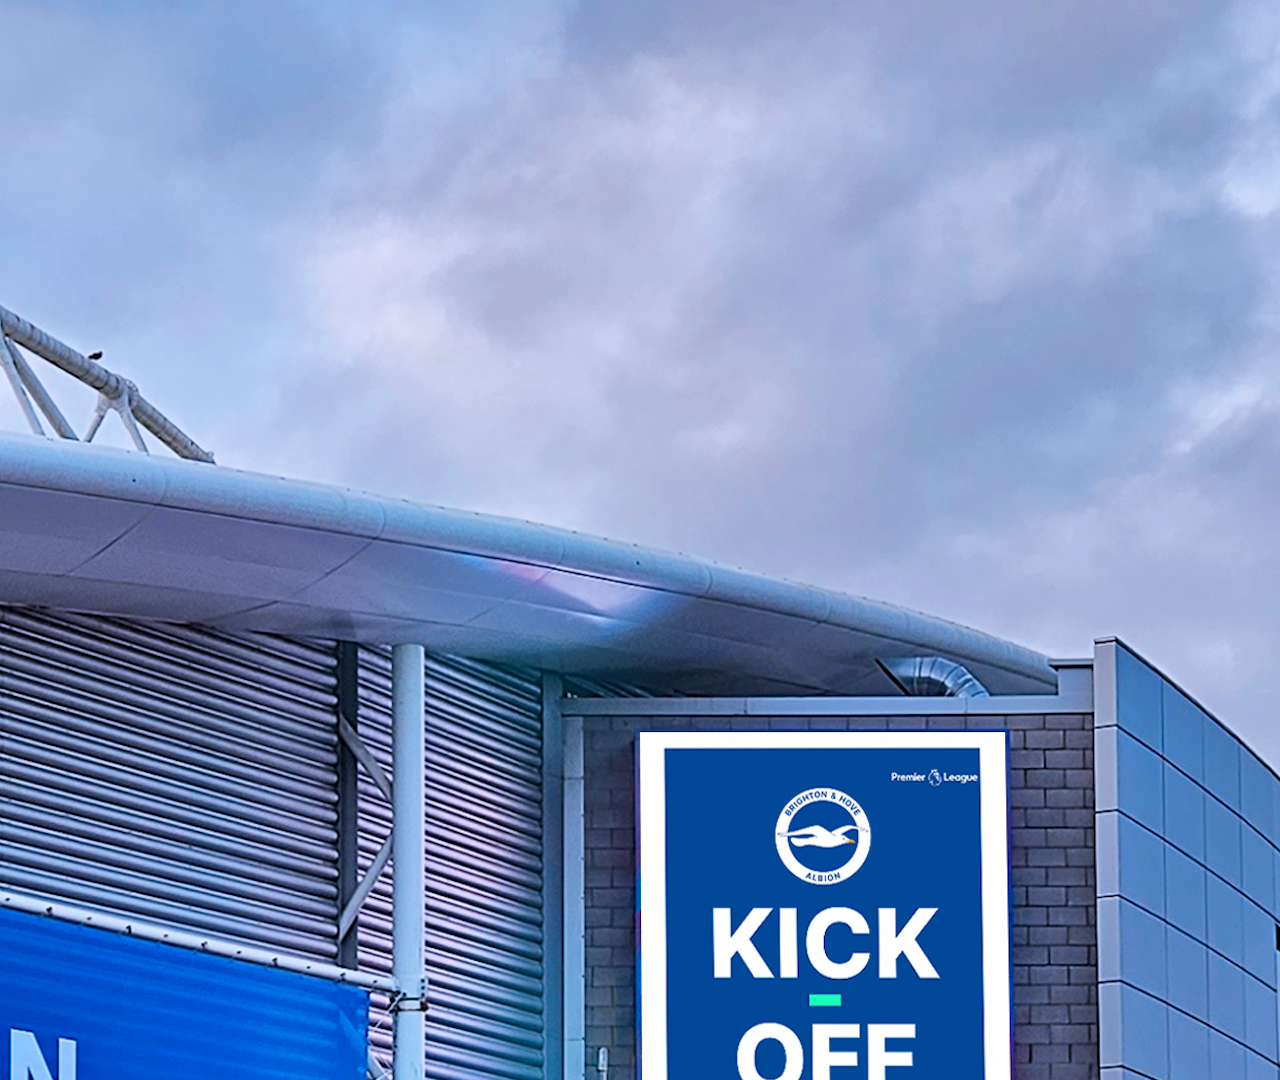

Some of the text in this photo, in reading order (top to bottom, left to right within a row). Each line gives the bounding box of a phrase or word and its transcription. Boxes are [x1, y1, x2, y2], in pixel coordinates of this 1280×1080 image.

[891, 772, 978, 784] Premier League
[784, 791, 827, 817] BRIGHTON
[839, 795, 861, 817] HOVE
[805, 871, 841, 882] ALBION
[712, 906, 941, 979] KICK
